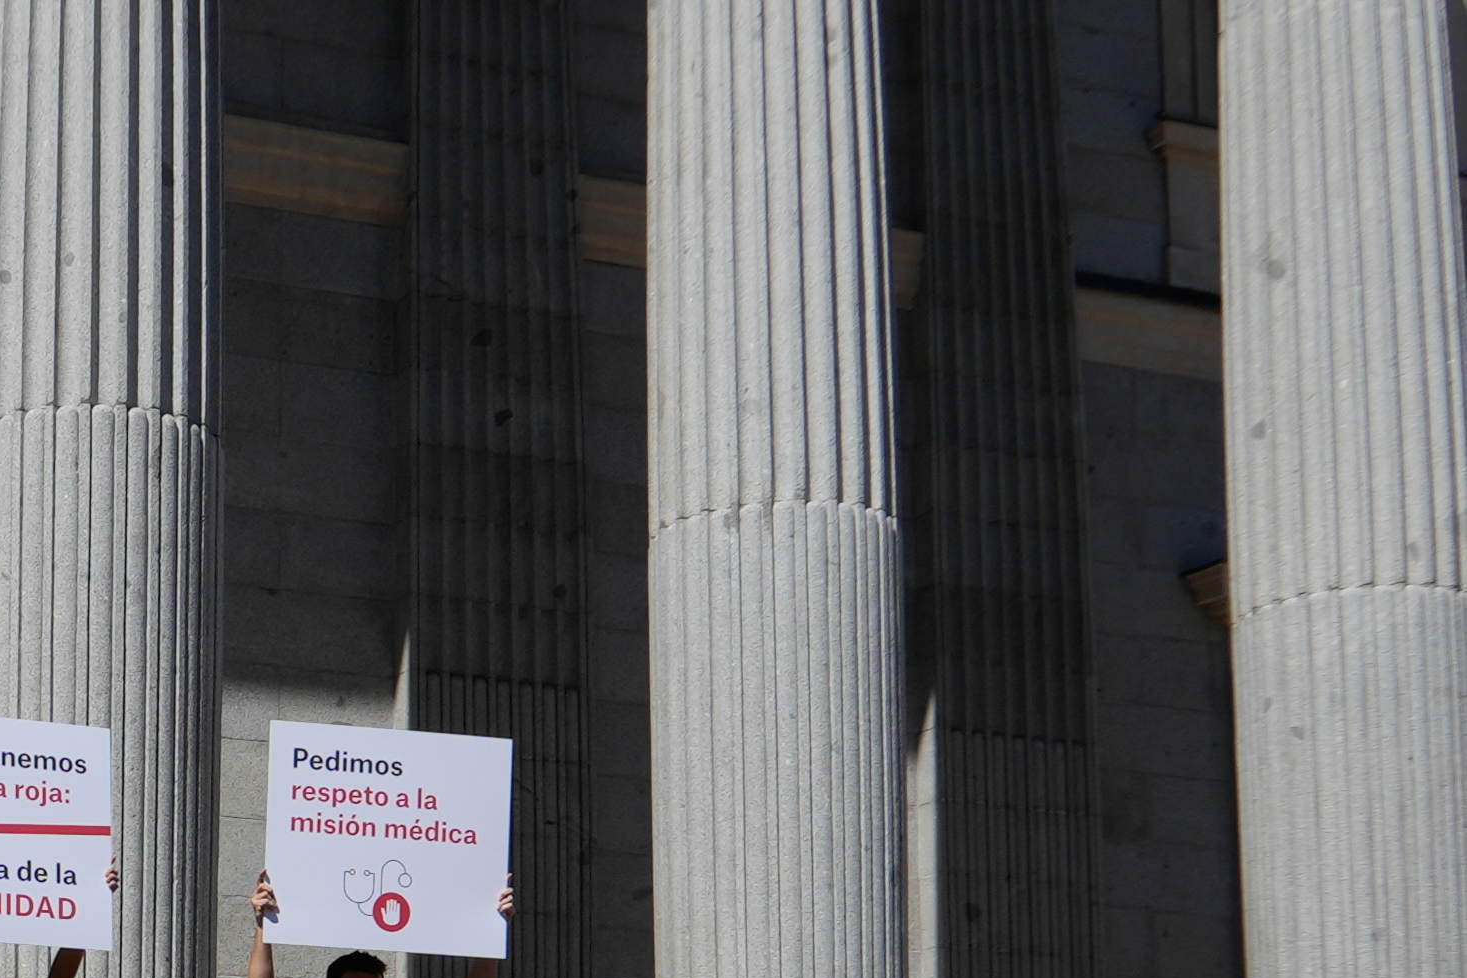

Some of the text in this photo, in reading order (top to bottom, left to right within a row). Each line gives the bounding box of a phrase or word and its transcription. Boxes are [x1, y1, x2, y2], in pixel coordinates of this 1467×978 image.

[293, 747, 403, 777] Pedimos
[15, 780, 70, 807] roja:
[291, 784, 438, 811] respeto a la
[290, 811, 477, 845] misión médica
[16, 859, 48, 883] de
[56, 862, 78, 886] la
